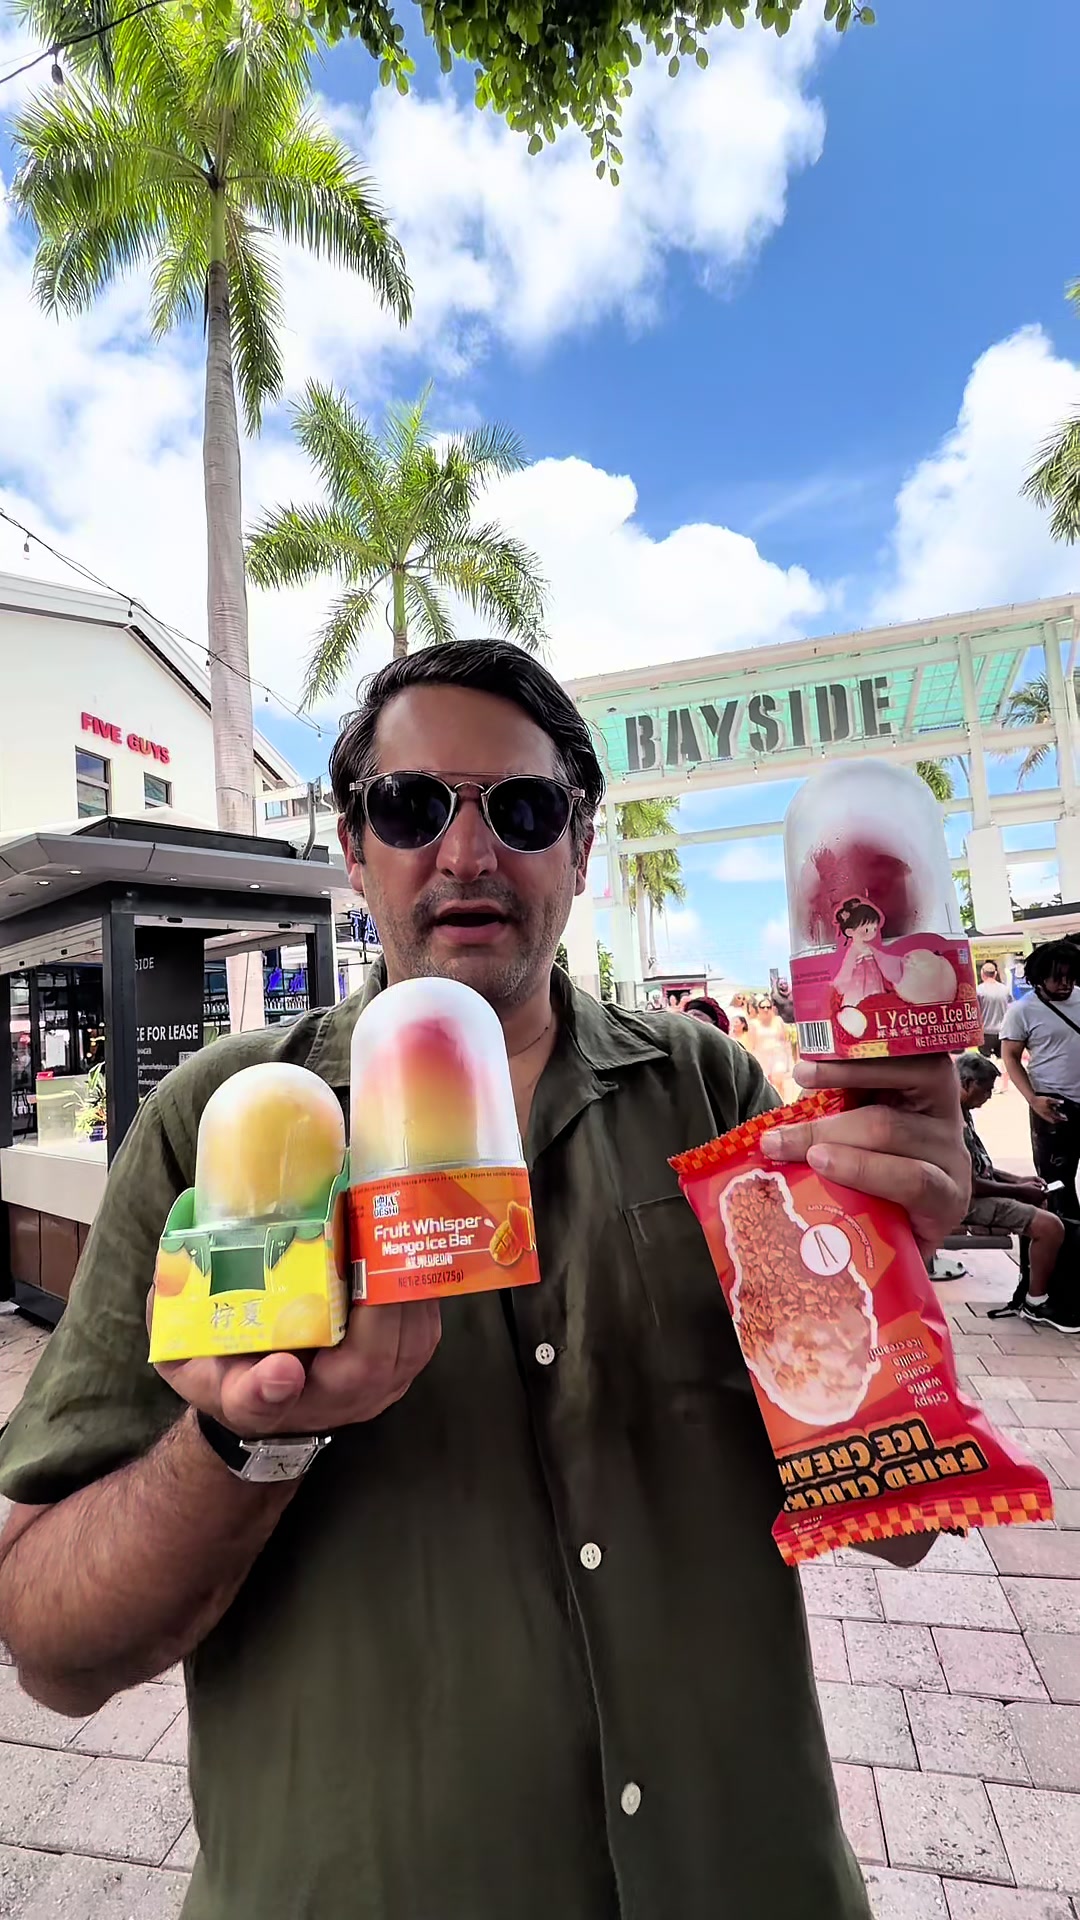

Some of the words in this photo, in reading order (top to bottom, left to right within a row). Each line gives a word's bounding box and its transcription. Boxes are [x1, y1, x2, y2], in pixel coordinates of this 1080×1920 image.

[625, 676, 892, 771] BAYSIDE
[81, 712, 122, 744] FIVE
[127, 733, 170, 763] GUYS
[940, 1005, 963, 1024] Ice
[147, 1026, 166, 1041] FOR
[168, 1024, 198, 1040] LEASE
[927, 1023, 954, 1034] FRUIT
[374, 1220, 411, 1242] Fruit
[412, 1216, 482, 1235] Whisper
[382, 1240, 425, 1256] Mango
[425, 1235, 448, 1251] Ice
[448, 1233, 475, 1247] Bar
[906, 1338, 923, 1348] ice
[892, 1350, 928, 1368] vanilla
[914, 1390, 949, 1409] Crispy
[875, 1425, 929, 1458] ICE
[777, 1441, 871, 1486] CREAM
[884, 1447, 983, 1489] FRIED
